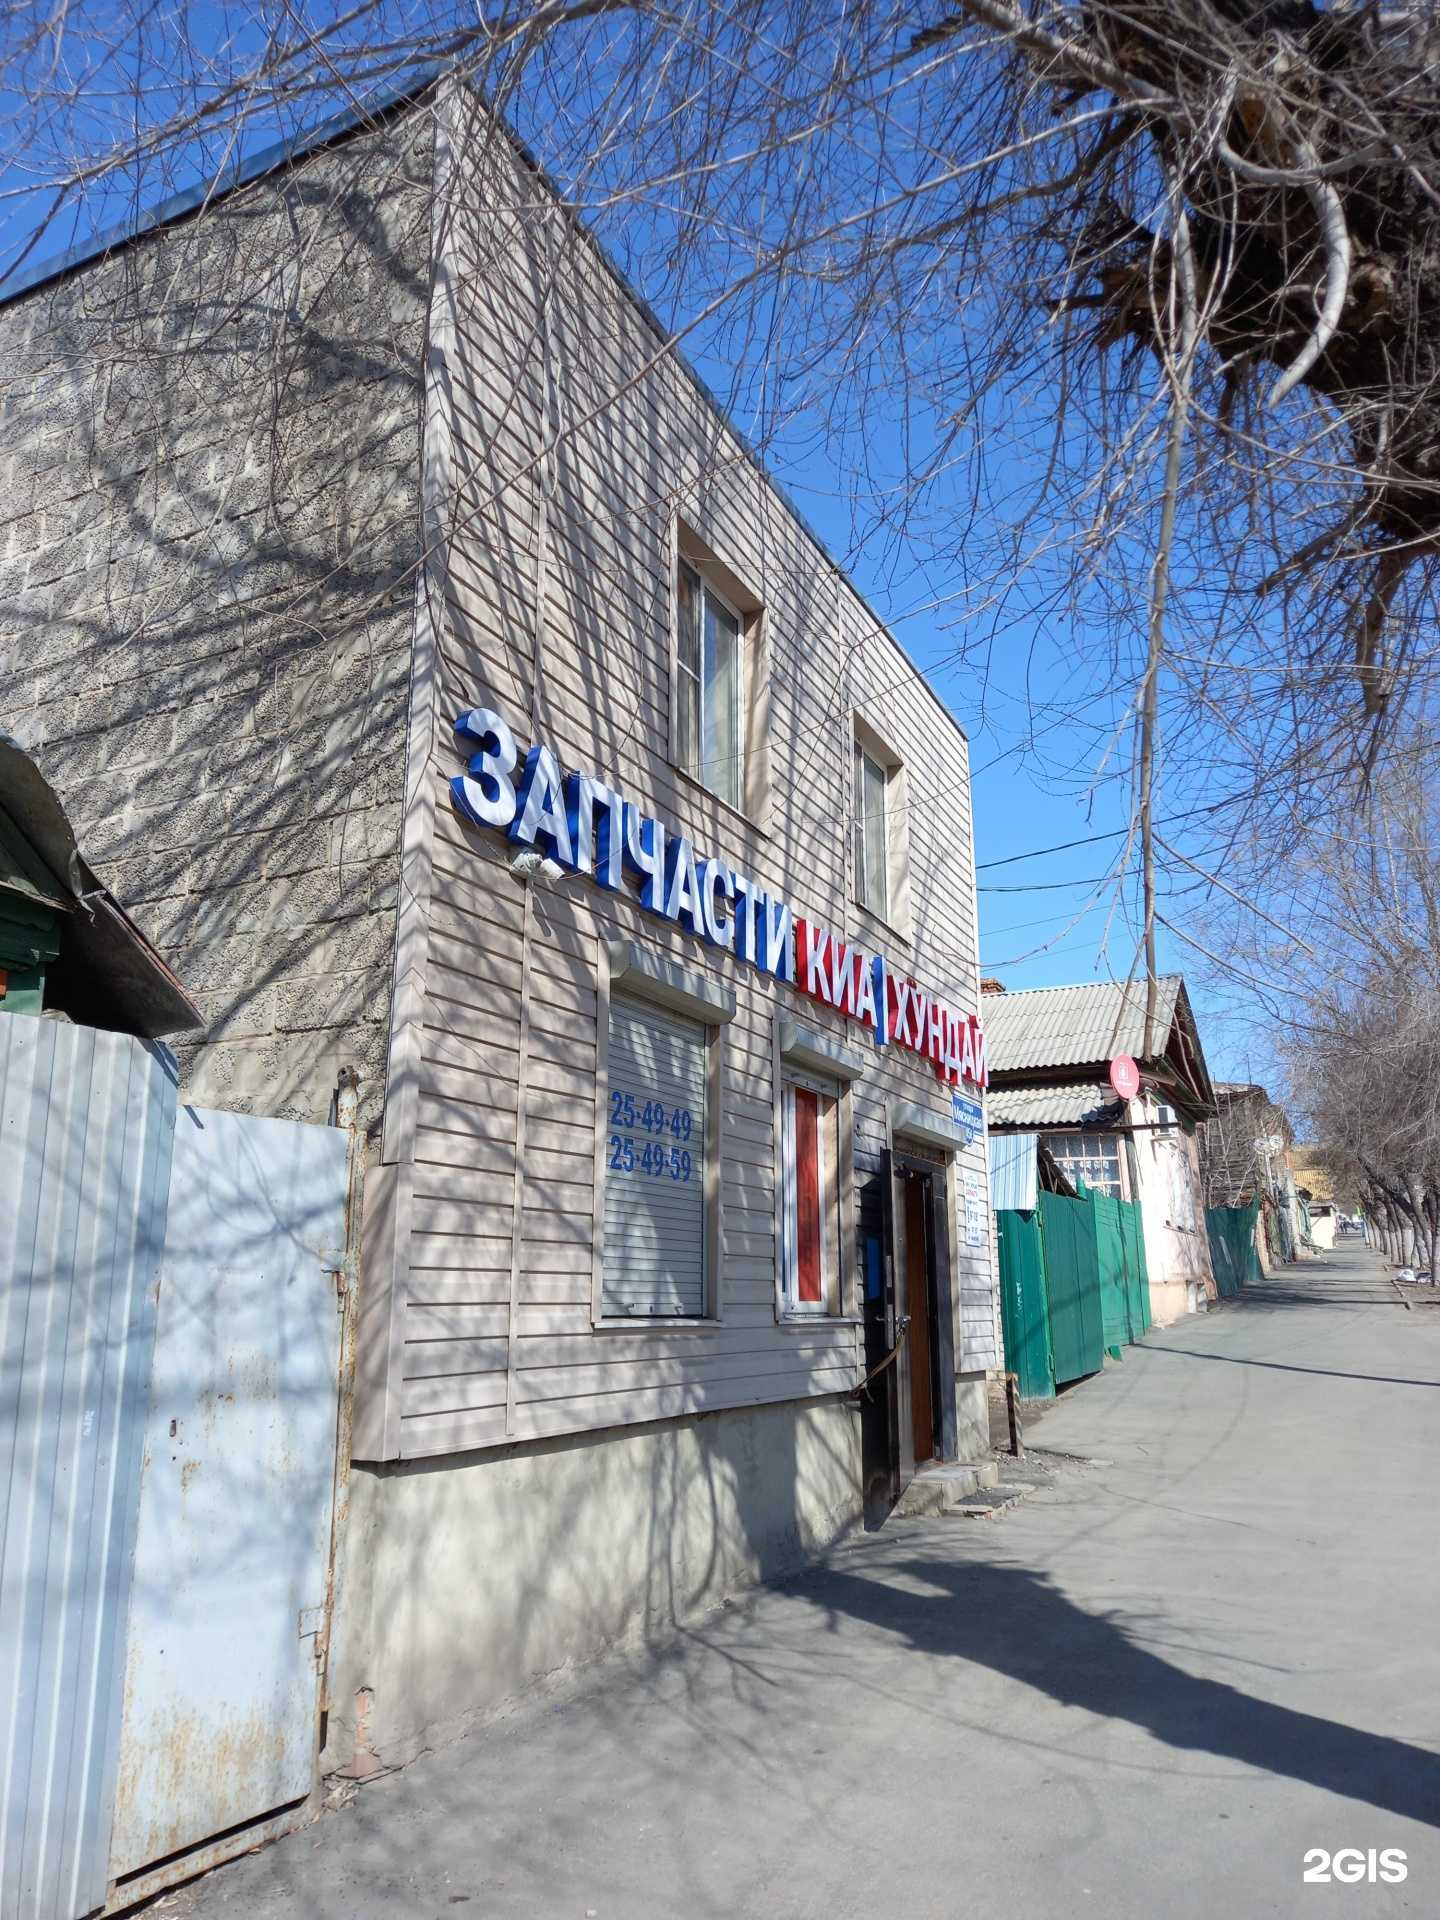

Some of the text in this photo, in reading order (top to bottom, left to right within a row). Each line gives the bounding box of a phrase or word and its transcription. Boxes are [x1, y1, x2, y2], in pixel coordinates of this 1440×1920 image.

[449, 708, 794, 982] ЗАПЧАСТИ
[797, 919, 878, 1027] КИА
[888, 974, 988, 1088] ХУНДАЙ
[610, 1091, 691, 1141] 25-49-49
[610, 1135, 691, 1182] 25-49-59
